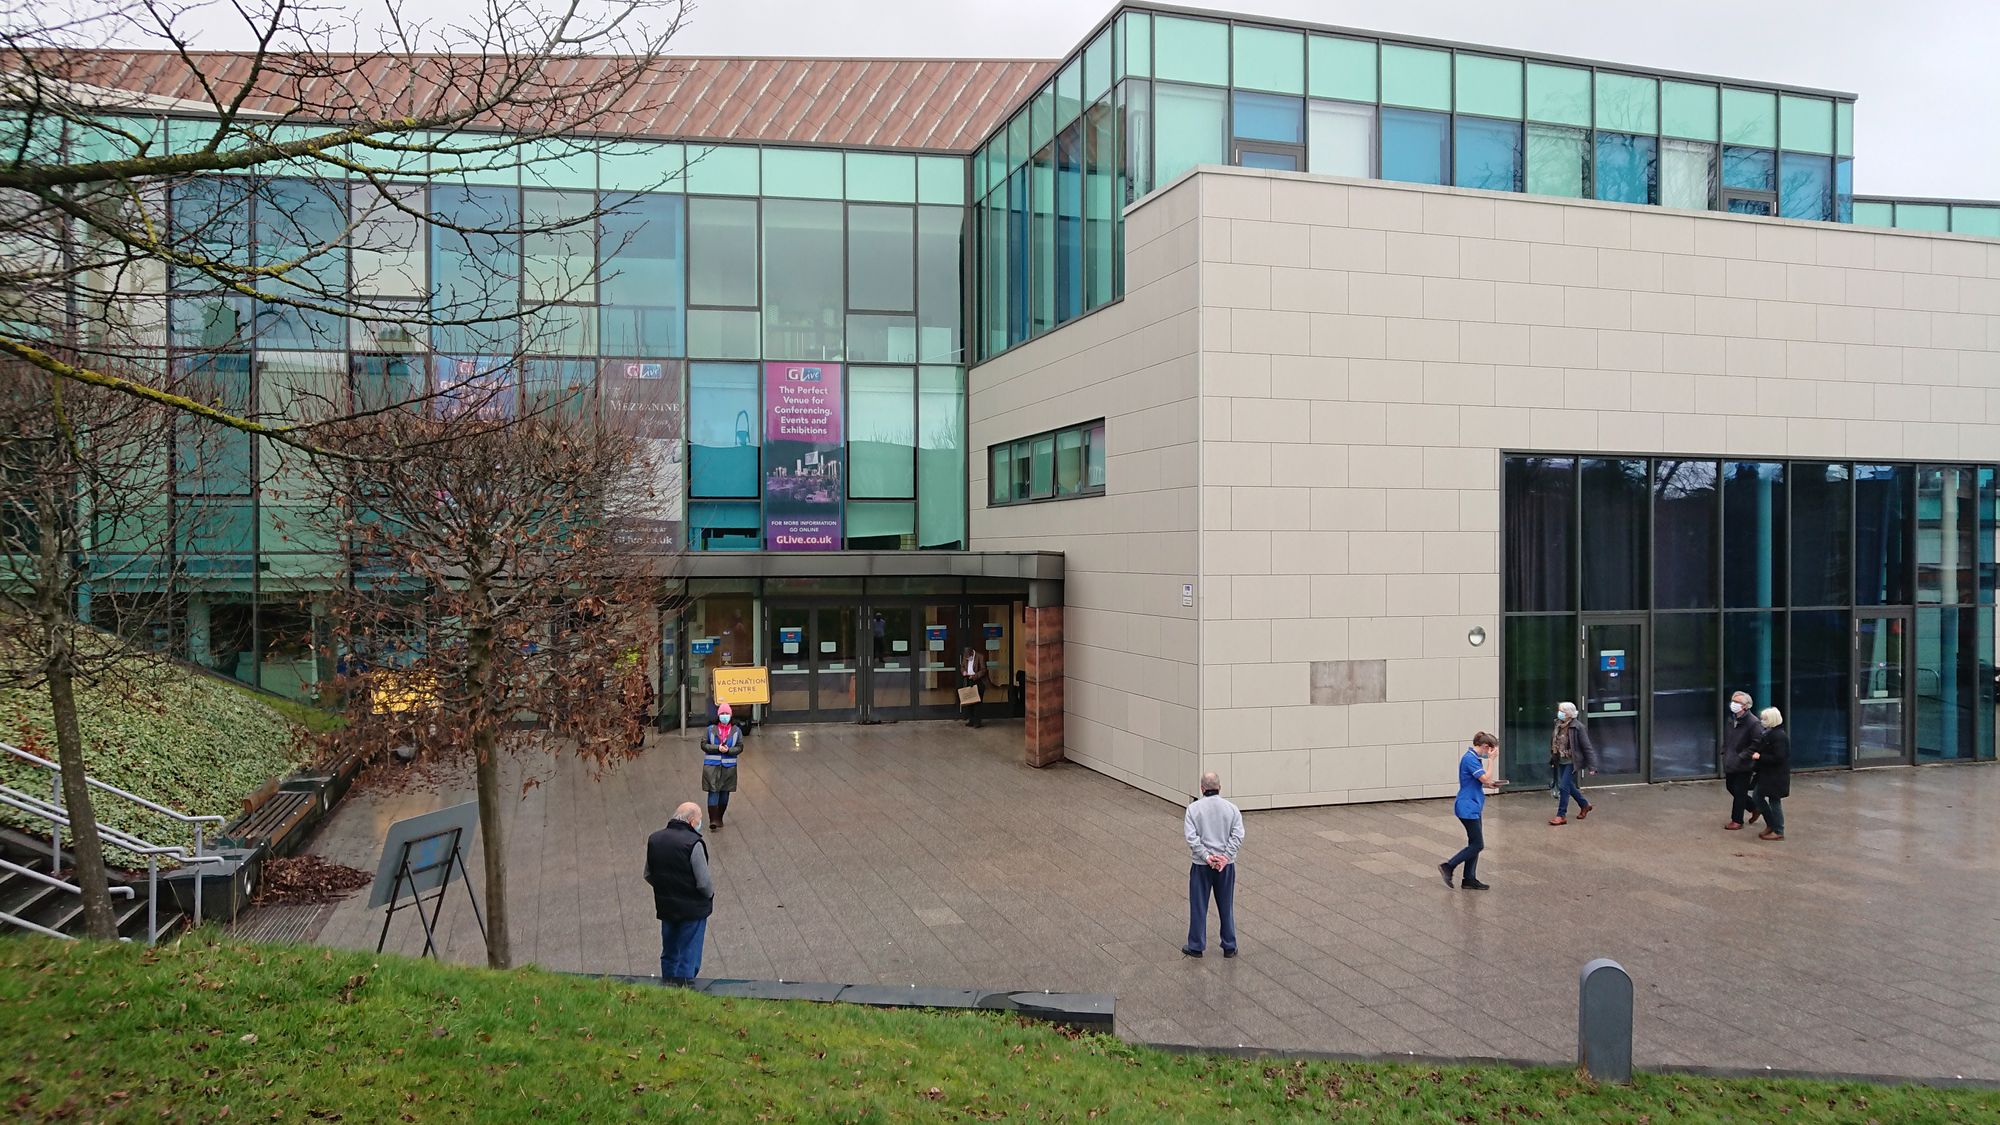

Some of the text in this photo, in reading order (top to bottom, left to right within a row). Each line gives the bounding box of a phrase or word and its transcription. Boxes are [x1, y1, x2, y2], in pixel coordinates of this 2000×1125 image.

[779, 386, 828, 395] The Perfect
[783, 396, 824, 405] Venue for
[774, 406, 833, 417] Conferencing,
[780, 416, 827, 425] Events and
[780, 426, 827, 435] Exhibitions
[776, 535, 832, 544] GLive.co.uk
[717, 677, 766, 686] VACCINATION
